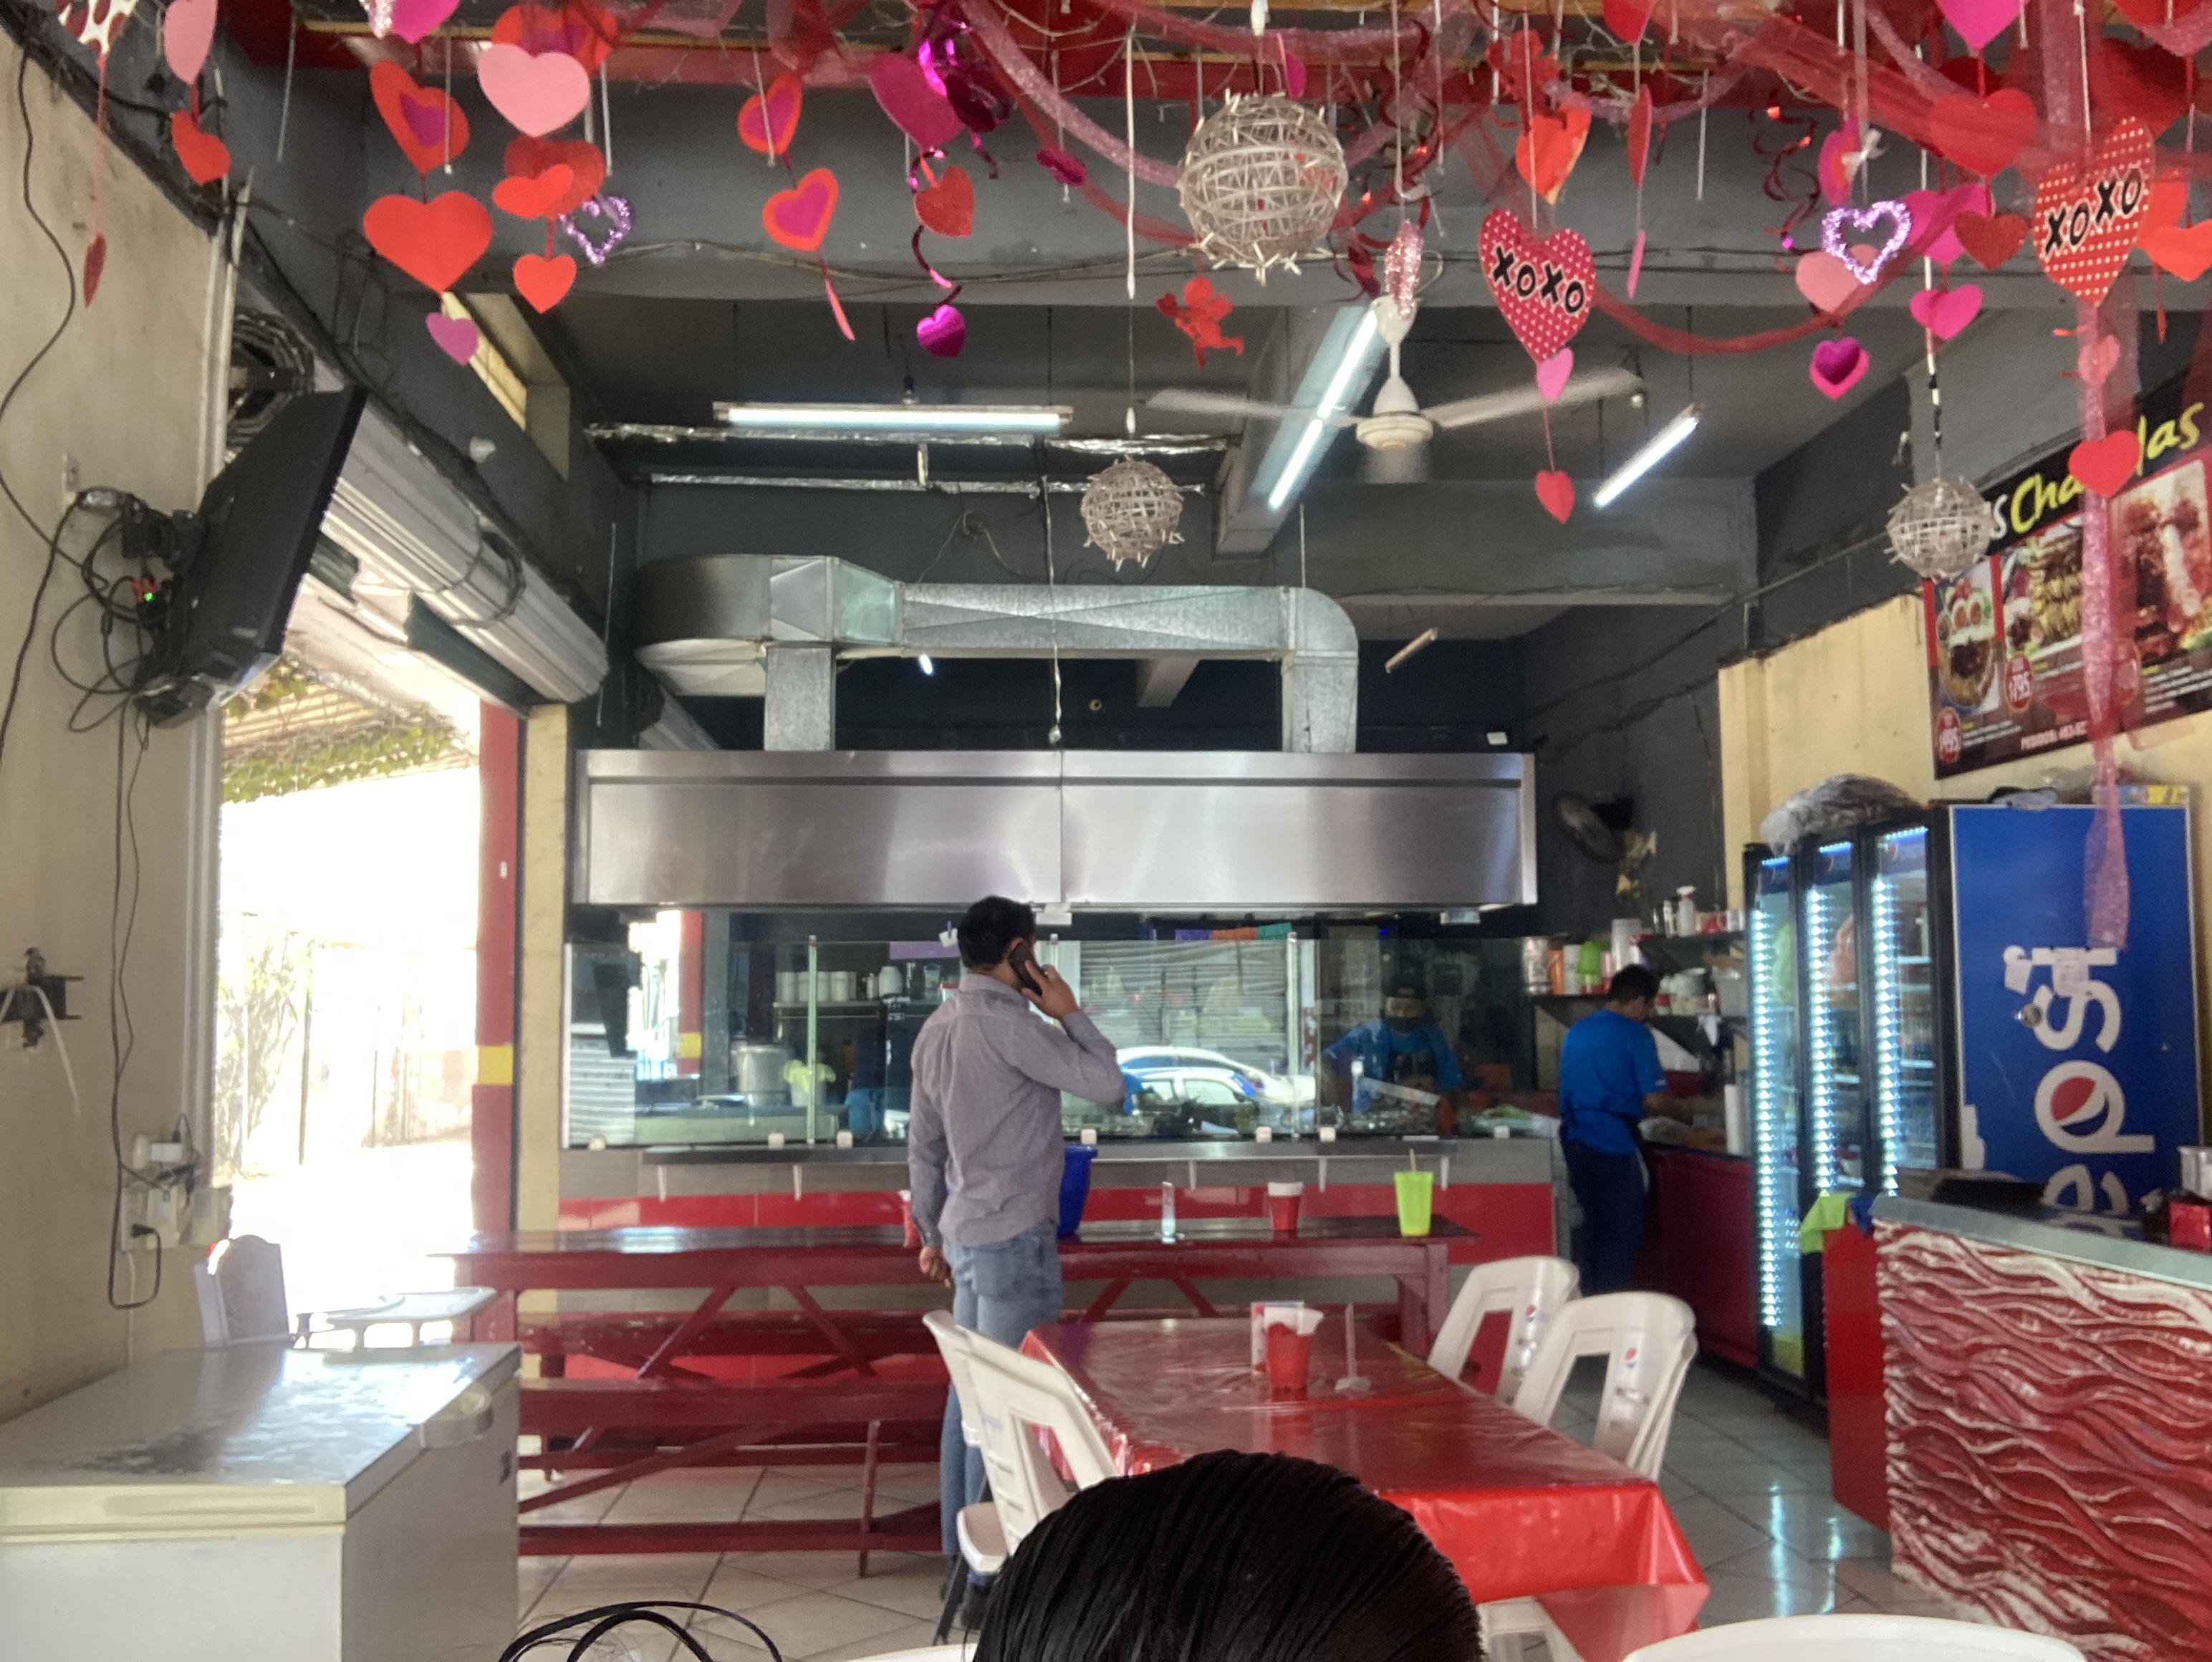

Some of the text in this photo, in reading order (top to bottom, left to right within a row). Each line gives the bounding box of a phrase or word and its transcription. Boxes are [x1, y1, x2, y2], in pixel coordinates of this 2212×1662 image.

[2044, 168, 2142, 254] XOXO
[1492, 246, 1585, 314] XOXO
[2011, 402, 2206, 533] Chalas
[2004, 946, 2155, 1214] epsi
